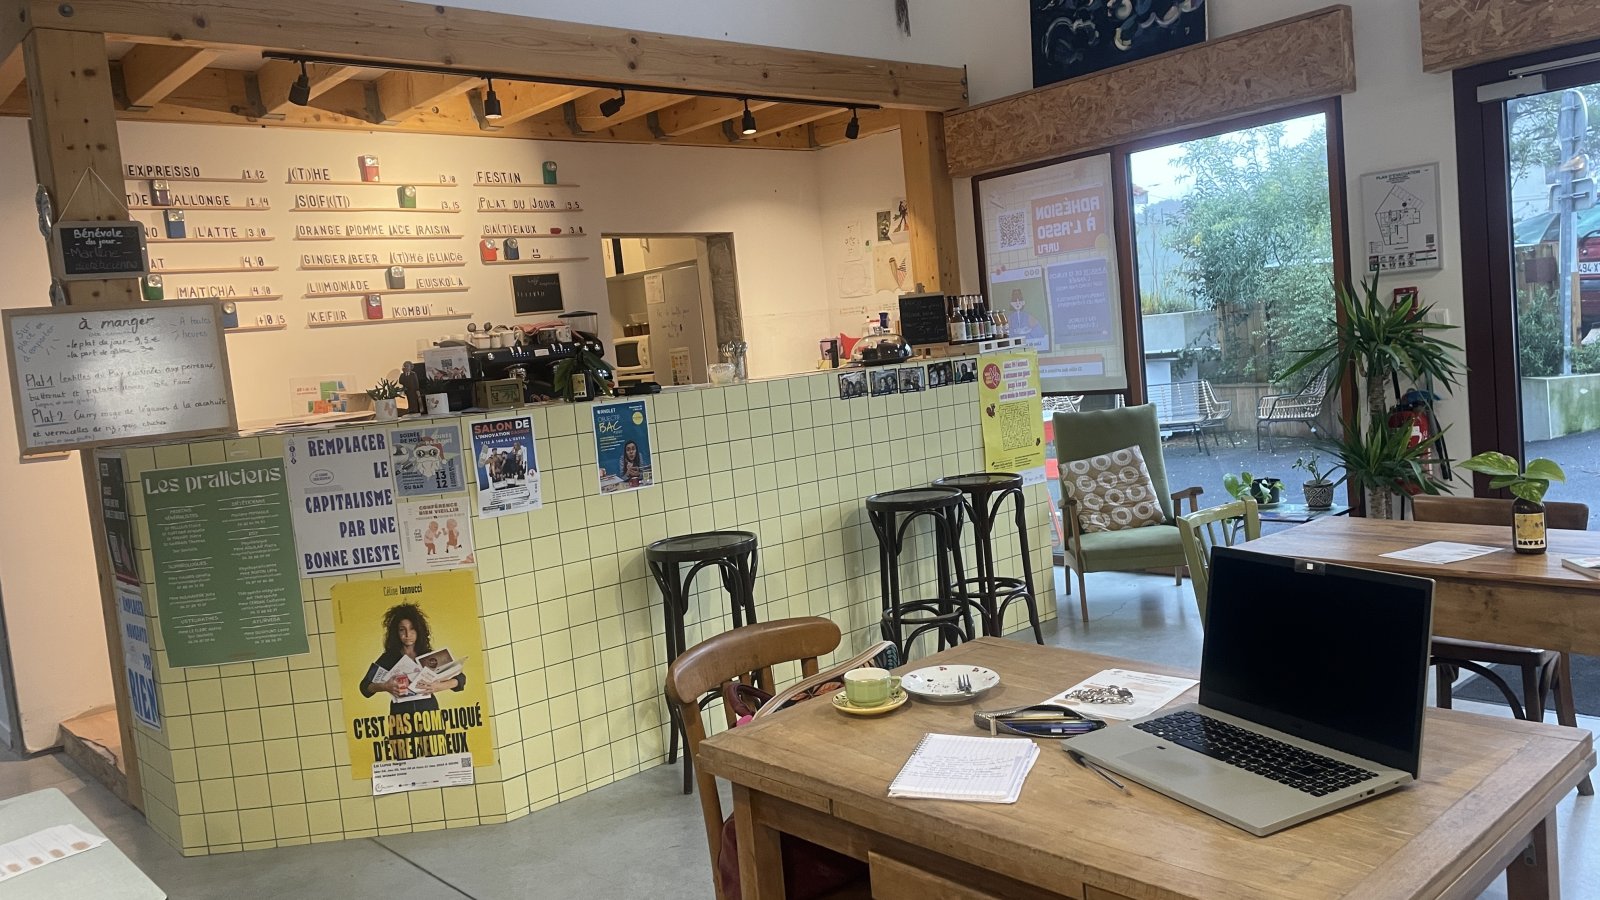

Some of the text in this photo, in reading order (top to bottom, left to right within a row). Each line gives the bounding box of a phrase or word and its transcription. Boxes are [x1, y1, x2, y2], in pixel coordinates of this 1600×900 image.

[128, 164, 200, 177] EXPRESSO
[292, 167, 330, 181] (T)HE
[478, 172, 521, 183] FESTIN
[174, 194, 231, 206] ALLONGE
[480, 197, 506, 209] PLAT
[531, 197, 556, 209] JOUR
[73, 227, 123, 239] Bénévole
[197, 227, 238, 237] LATTE
[299, 225, 451, 236] ORANGE POMME ACE RAISIN
[303, 253, 347, 264] GINGER
[352, 253, 379, 264] BEER
[179, 285, 236, 298] MATCHA
[309, 278, 463, 293] LIMONADE EUSKOLA
[311, 311, 348, 322] KEFIR
[15, 321, 32, 339] Sur
[78, 317, 92, 330] à
[101, 317, 155, 334] manger
[79, 340, 96, 350] plat
[109, 338, 127, 349] jour
[80, 349, 96, 359] part
[25, 373, 44, 387] Plat
[29, 391, 66, 402] butternut
[32, 408, 54, 423] Plat
[45, 426, 89, 437] vermicelles
[474, 419, 530, 434] SALON DE
[598, 420, 623, 433] BAC
[475, 431, 510, 440] L'INNOVATION
[307, 433, 386, 457] REMPLACER
[373, 461, 389, 479] LE
[435, 470, 447, 480] 13
[145, 478, 180, 495] Les
[436, 480, 448, 489] 12
[305, 489, 393, 514] CAPITALISME
[418, 502, 458, 511] CONFÉRENCE
[340, 520, 365, 538] PAR
[369, 516, 396, 536] UNE
[304, 549, 349, 570] BONNE
[352, 544, 400, 565] SIESTE
[383, 583, 423, 597] Céline Iannucci
[353, 702, 483, 740] C'EST PAS COMPLIQUÉ
[373, 731, 469, 762] D'ÊTRE HEUREUX
